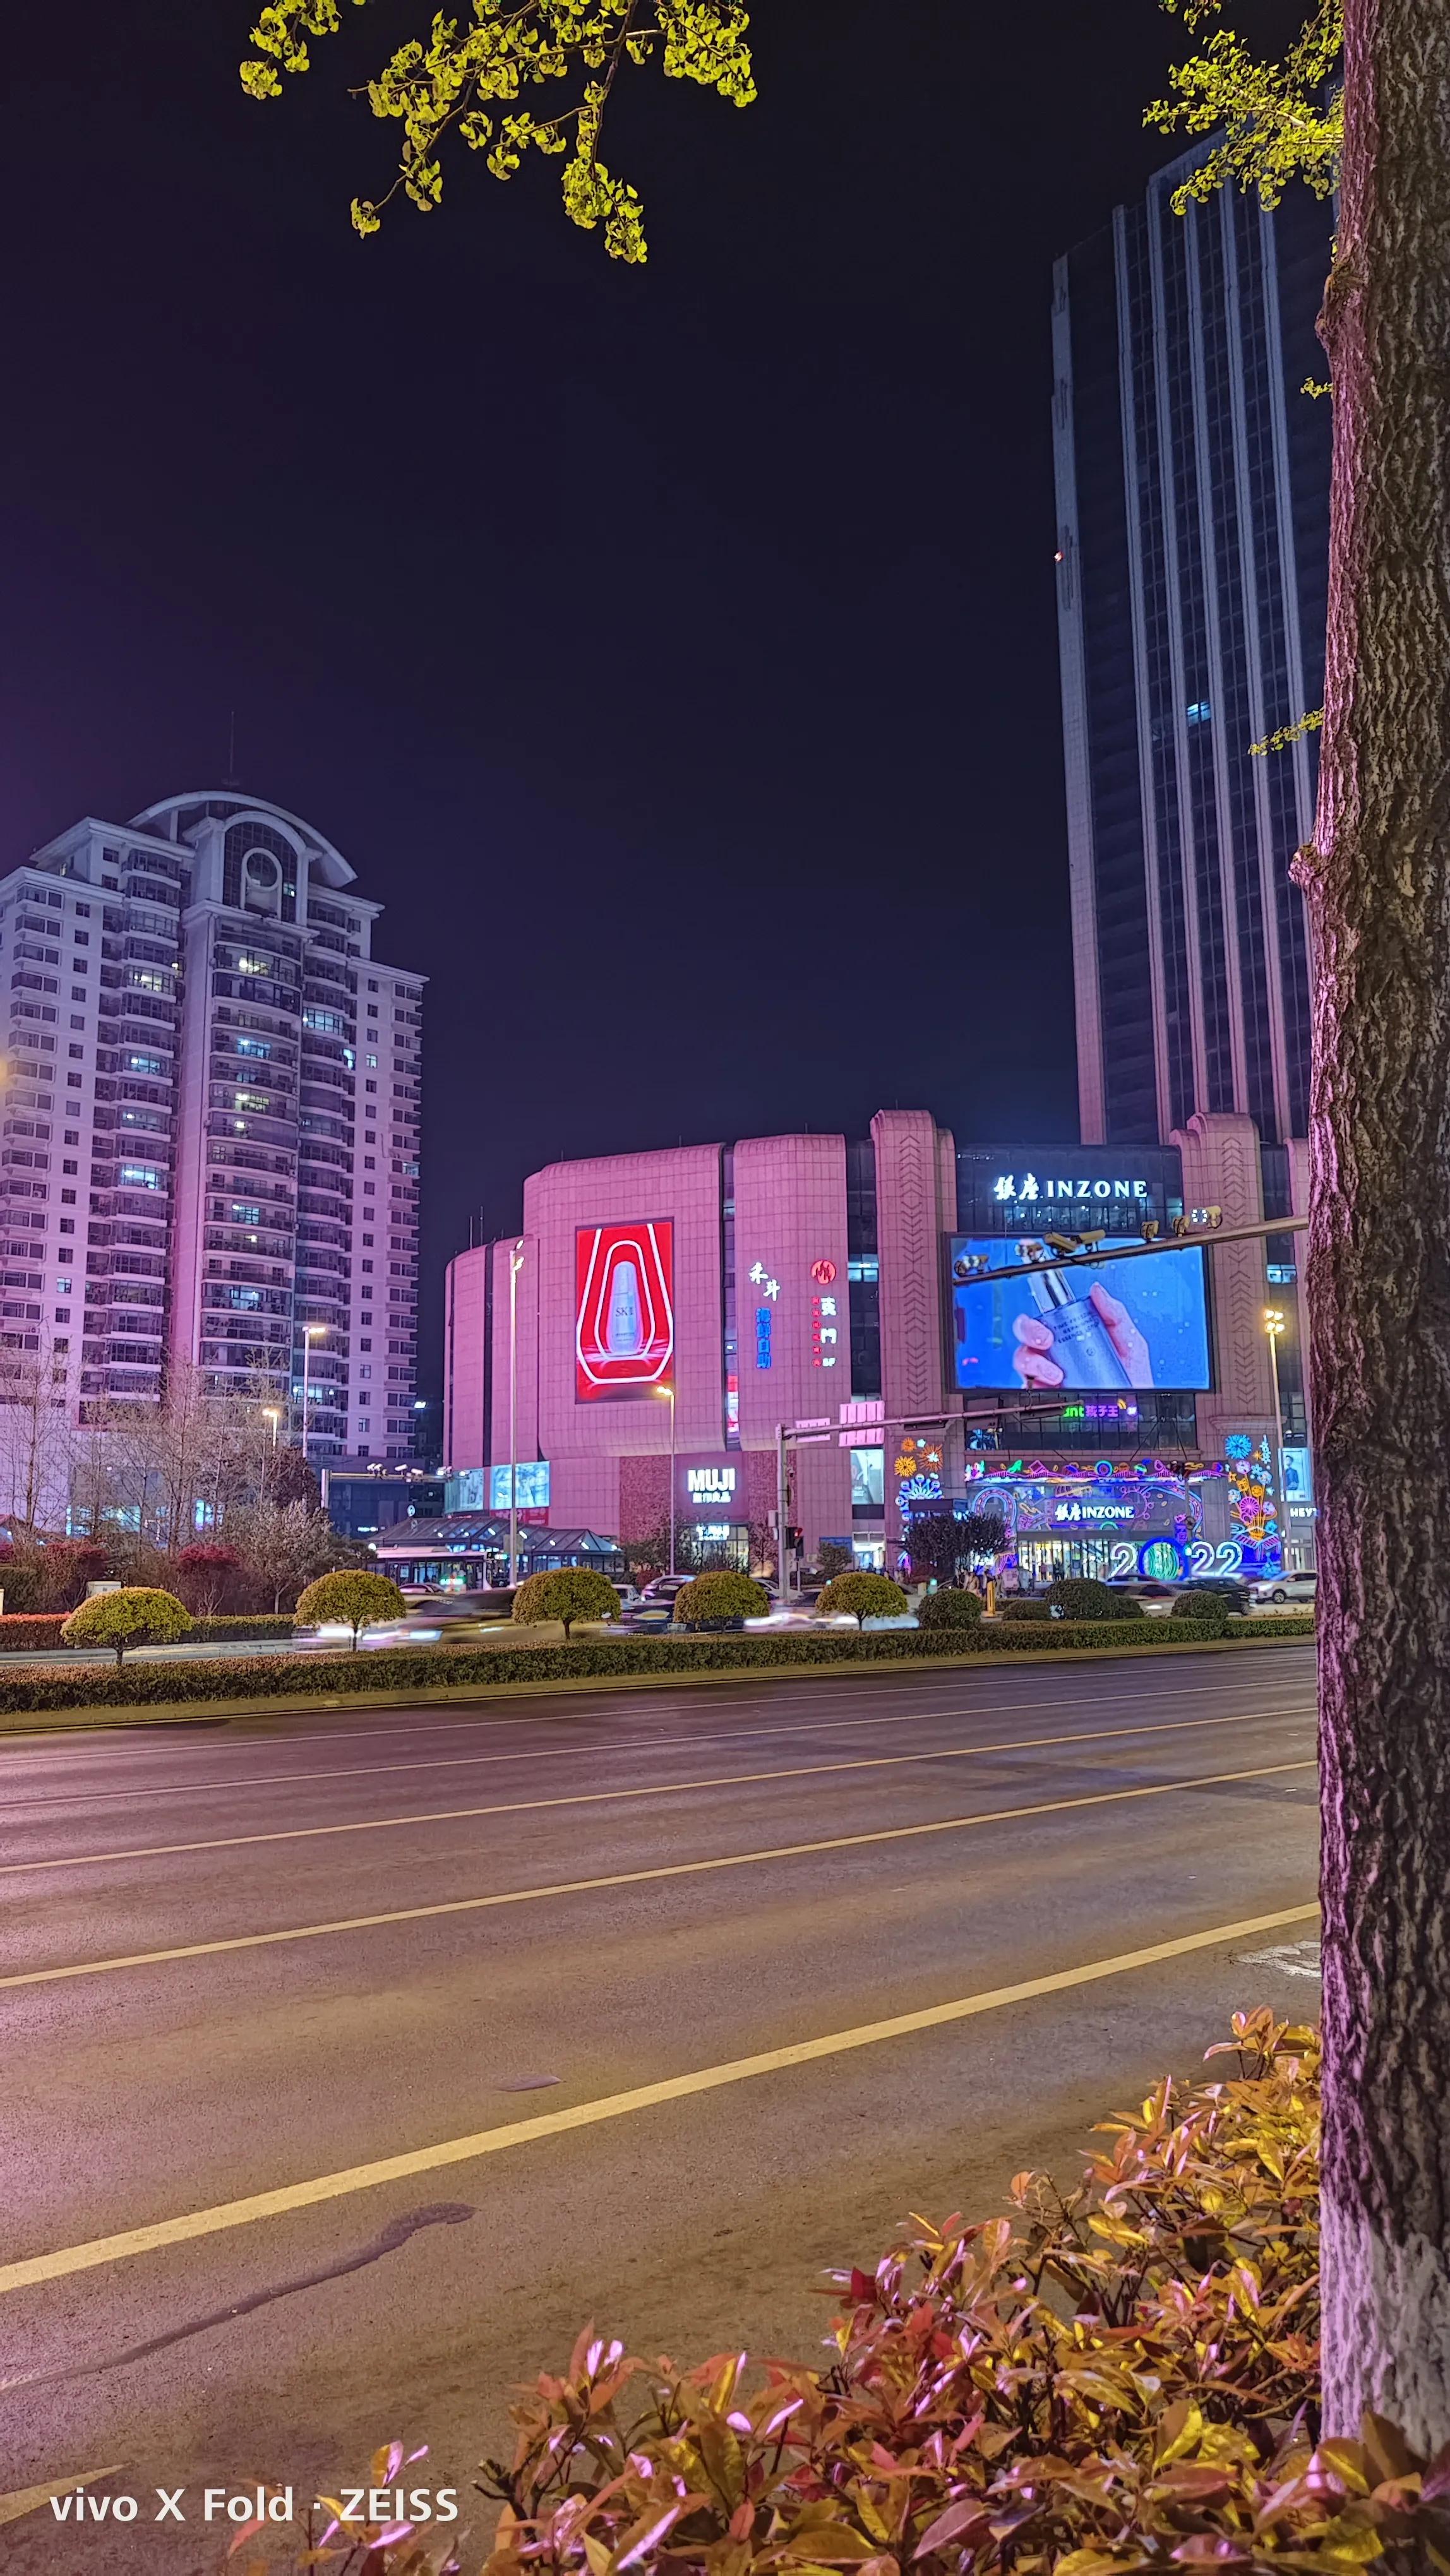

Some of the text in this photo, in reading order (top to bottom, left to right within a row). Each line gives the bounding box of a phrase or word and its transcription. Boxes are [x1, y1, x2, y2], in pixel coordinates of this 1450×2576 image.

[1046, 1180, 1147, 1198] INZONE
[1086, 1405, 1118, 1417] 孩子王
[688, 1468, 735, 1491] MUJI
[1082, 1505, 1134, 1518] INZONE
